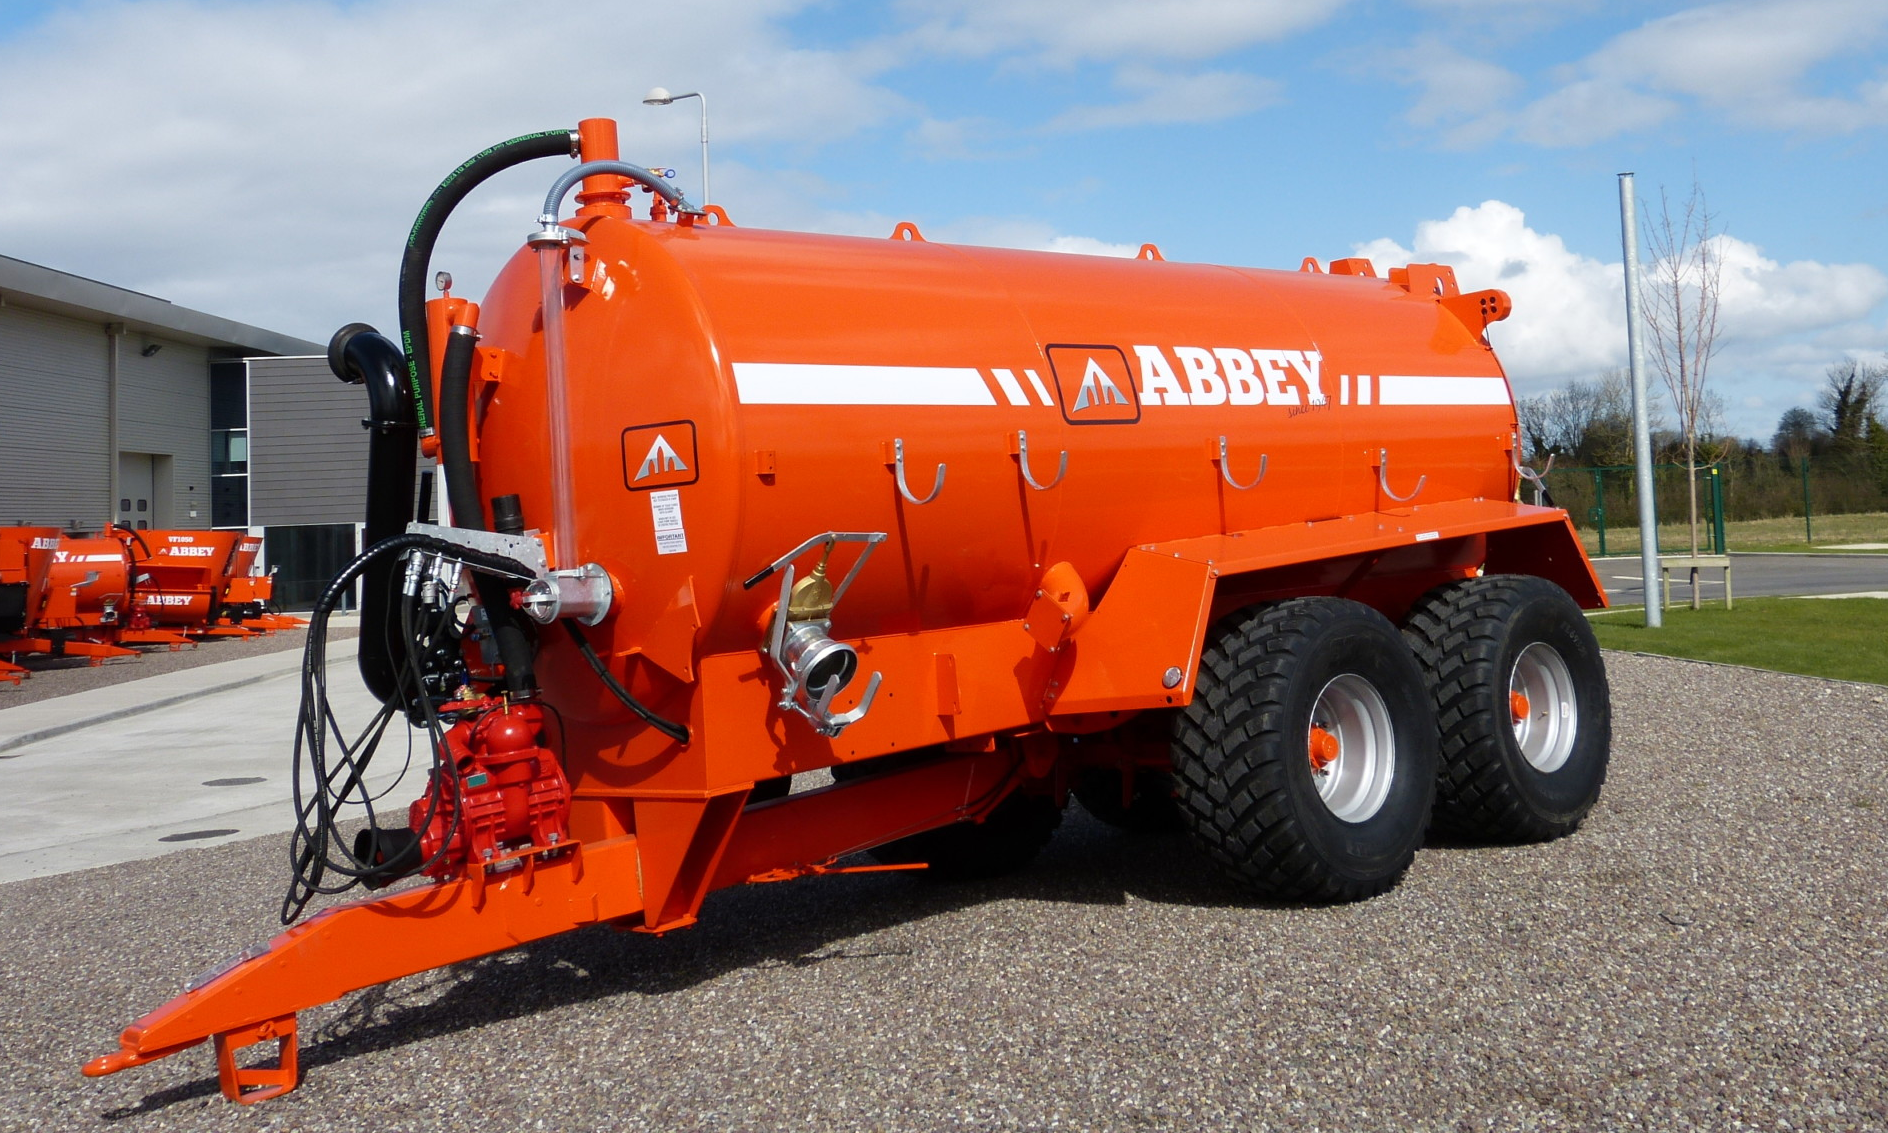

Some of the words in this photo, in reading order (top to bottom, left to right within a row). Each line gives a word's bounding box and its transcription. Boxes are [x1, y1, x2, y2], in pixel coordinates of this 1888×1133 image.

[403, 330, 413, 354] EPDM
[408, 360, 421, 399] PURPOSE
[1132, 345, 1323, 406] ABBEY
[416, 400, 427, 429] ENERAL
[1287, 404, 1310, 419] since
[657, 533, 684, 541] IMPORTANT
[169, 546, 215, 556] ABBEY
[147, 595, 193, 606] ABBEY
